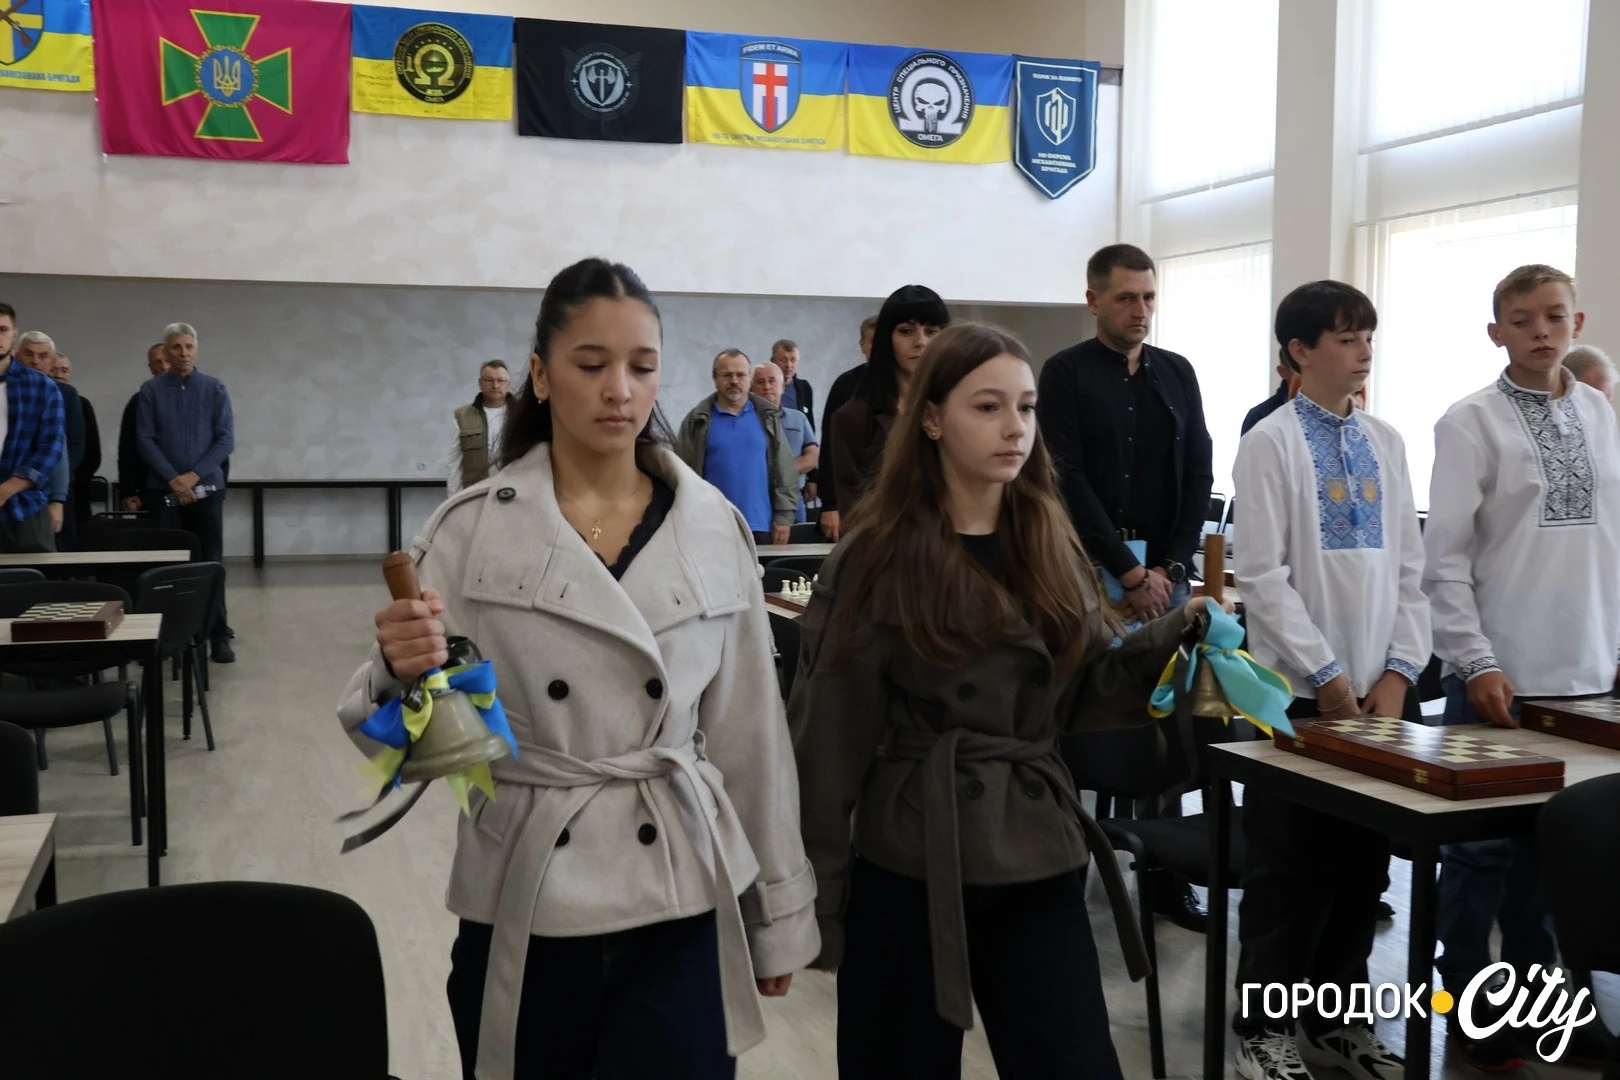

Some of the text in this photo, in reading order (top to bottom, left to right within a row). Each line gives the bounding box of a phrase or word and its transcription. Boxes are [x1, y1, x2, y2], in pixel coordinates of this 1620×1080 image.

[742, 44, 765, 54] FIDEM
[776, 46, 799, 58] ARMA
[892, 58, 971, 120] ЦЕНТР СПЕЦІАЛЬНОГО ПРИЗНАЧЕННЯ
[917, 133, 944, 142] ОМЕГА
[1041, 166, 1069, 174] БРИГАДА
